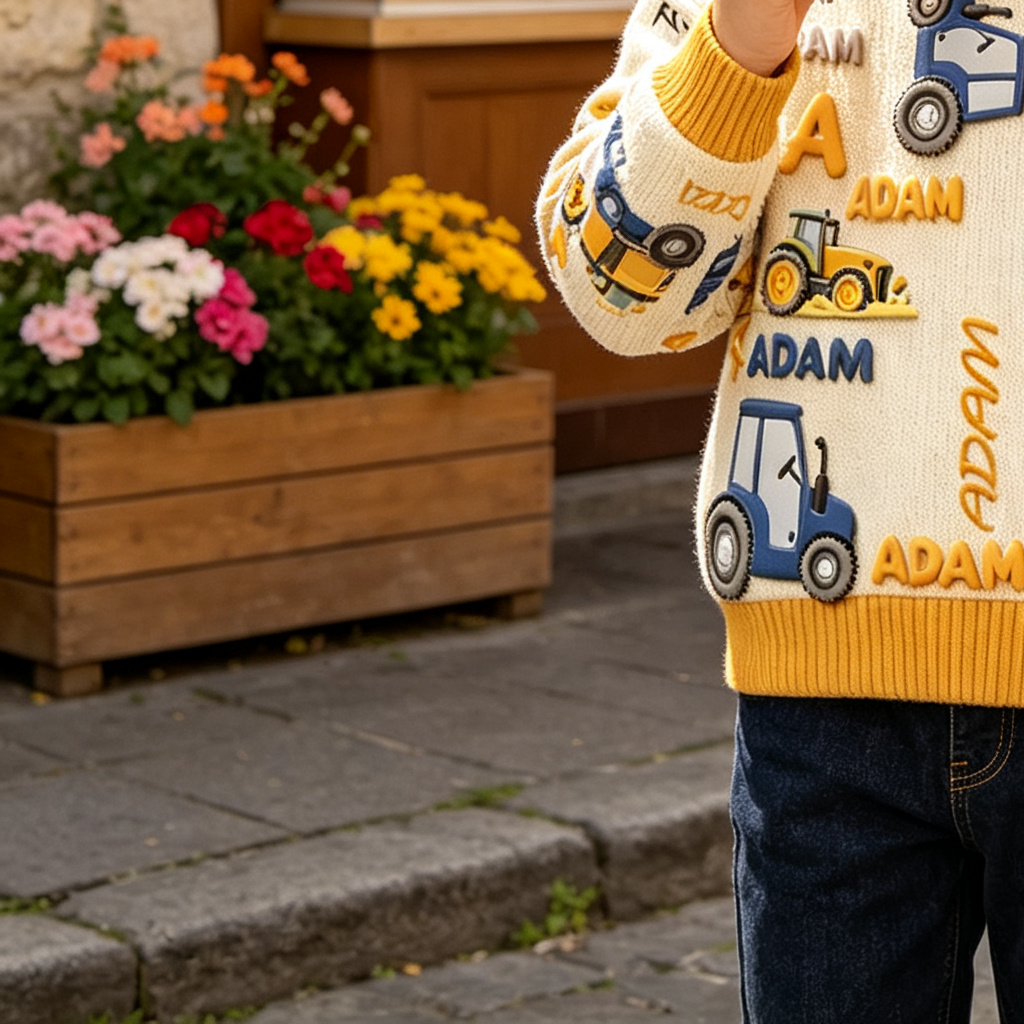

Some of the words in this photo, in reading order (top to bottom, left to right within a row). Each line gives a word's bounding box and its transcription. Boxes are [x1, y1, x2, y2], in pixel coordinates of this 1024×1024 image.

[799, 25, 864, 67] AM
[778, 92, 847, 178] A
[845, 174, 964, 223] ADAM
[747, 332, 875, 383] ADAM
[958, 316, 1000, 532] ADAM
